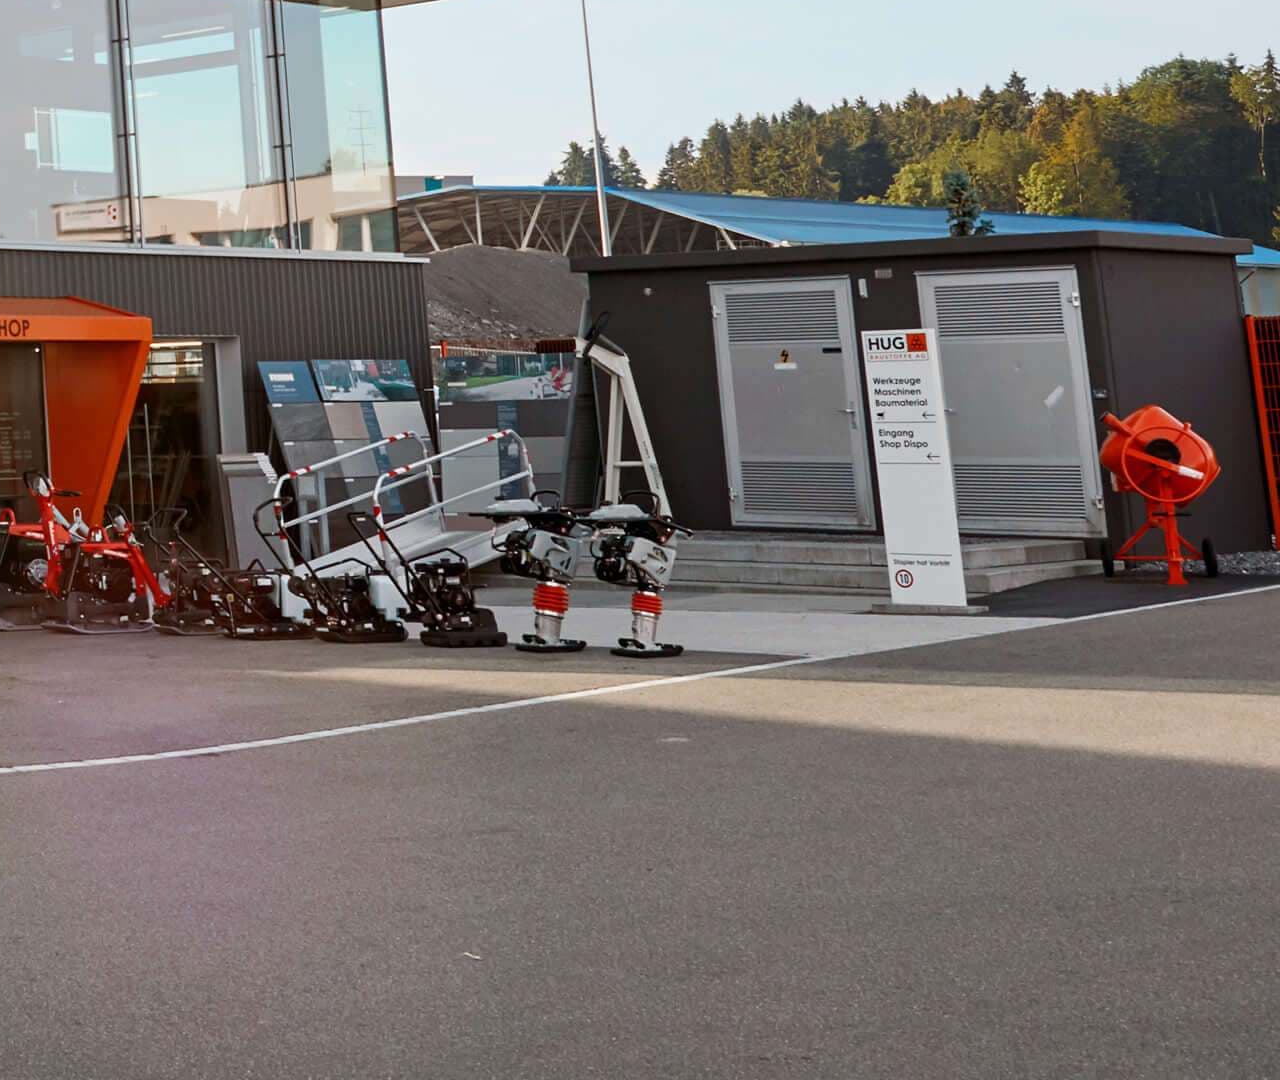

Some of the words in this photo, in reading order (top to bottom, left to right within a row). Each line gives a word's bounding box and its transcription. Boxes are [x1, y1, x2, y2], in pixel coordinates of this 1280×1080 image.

[868, 337, 905, 350] HUG
[872, 378, 921, 386] Werkzeuge
[874, 388, 922, 396] Maschinen
[875, 398, 928, 407] Baumaterial
[879, 429, 914, 438] Eingang
[879, 441, 901, 449] Shop
[904, 440, 928, 448] Dispo
[900, 574, 909, 584] 10
